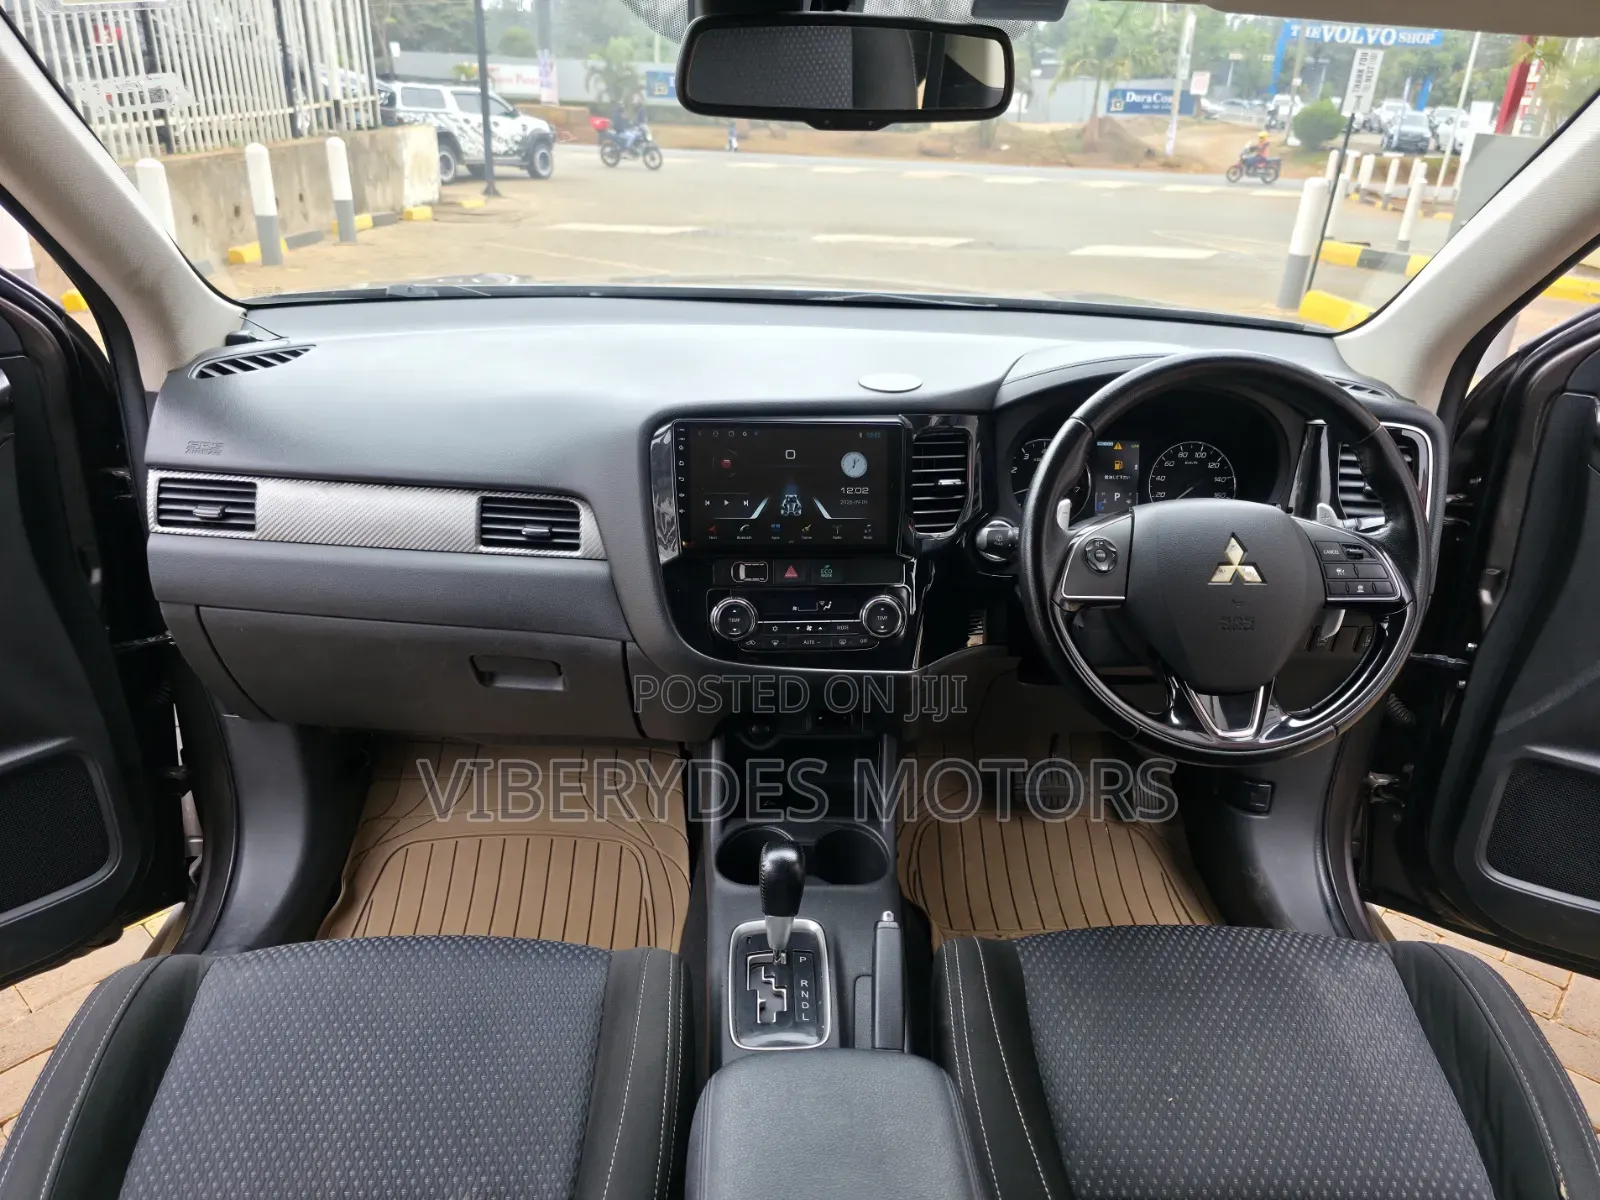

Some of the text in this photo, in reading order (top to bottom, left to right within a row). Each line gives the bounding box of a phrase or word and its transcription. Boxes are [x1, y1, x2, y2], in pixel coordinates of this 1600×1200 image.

[1320, 25, 1397, 46] VOLVO
[1398, 31, 1436, 44] SHOP
[1010, 466, 1018, 474] 2
[1114, 492, 1121, 501] P
[801, 1001, 810, 1009] D
[802, 1013, 810, 1021] L
